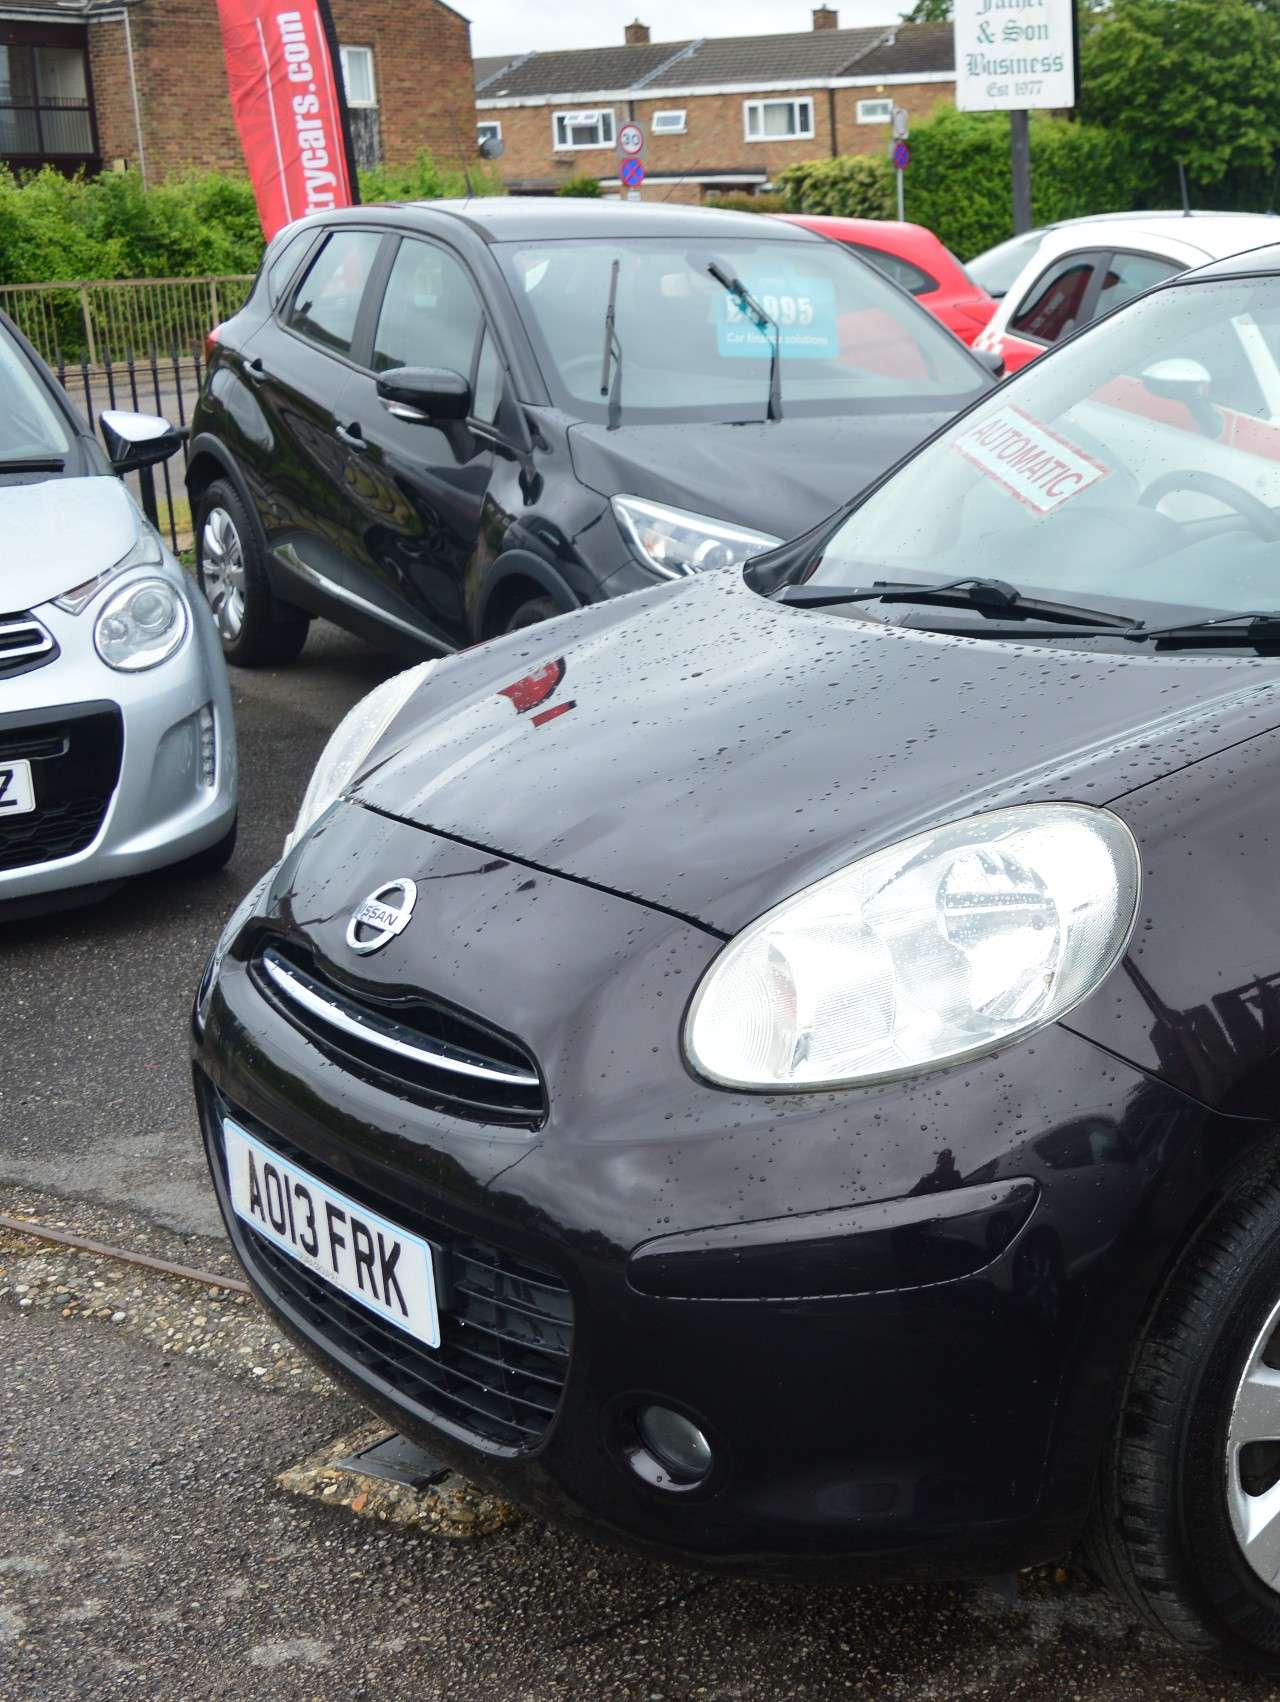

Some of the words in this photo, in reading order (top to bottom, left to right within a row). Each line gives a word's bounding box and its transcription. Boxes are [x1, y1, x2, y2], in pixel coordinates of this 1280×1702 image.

[976, 20, 996, 43] &
[1003, 19, 1049, 41] Son
[965, 53, 1064, 76] Business
[1015, 80, 1044, 96] 1977
[623, 133, 640, 146] 30
[725, 295, 813, 325] £995
[969, 418, 1083, 498] AUTOMATIC
[325, 1200, 409, 1317] FRK
